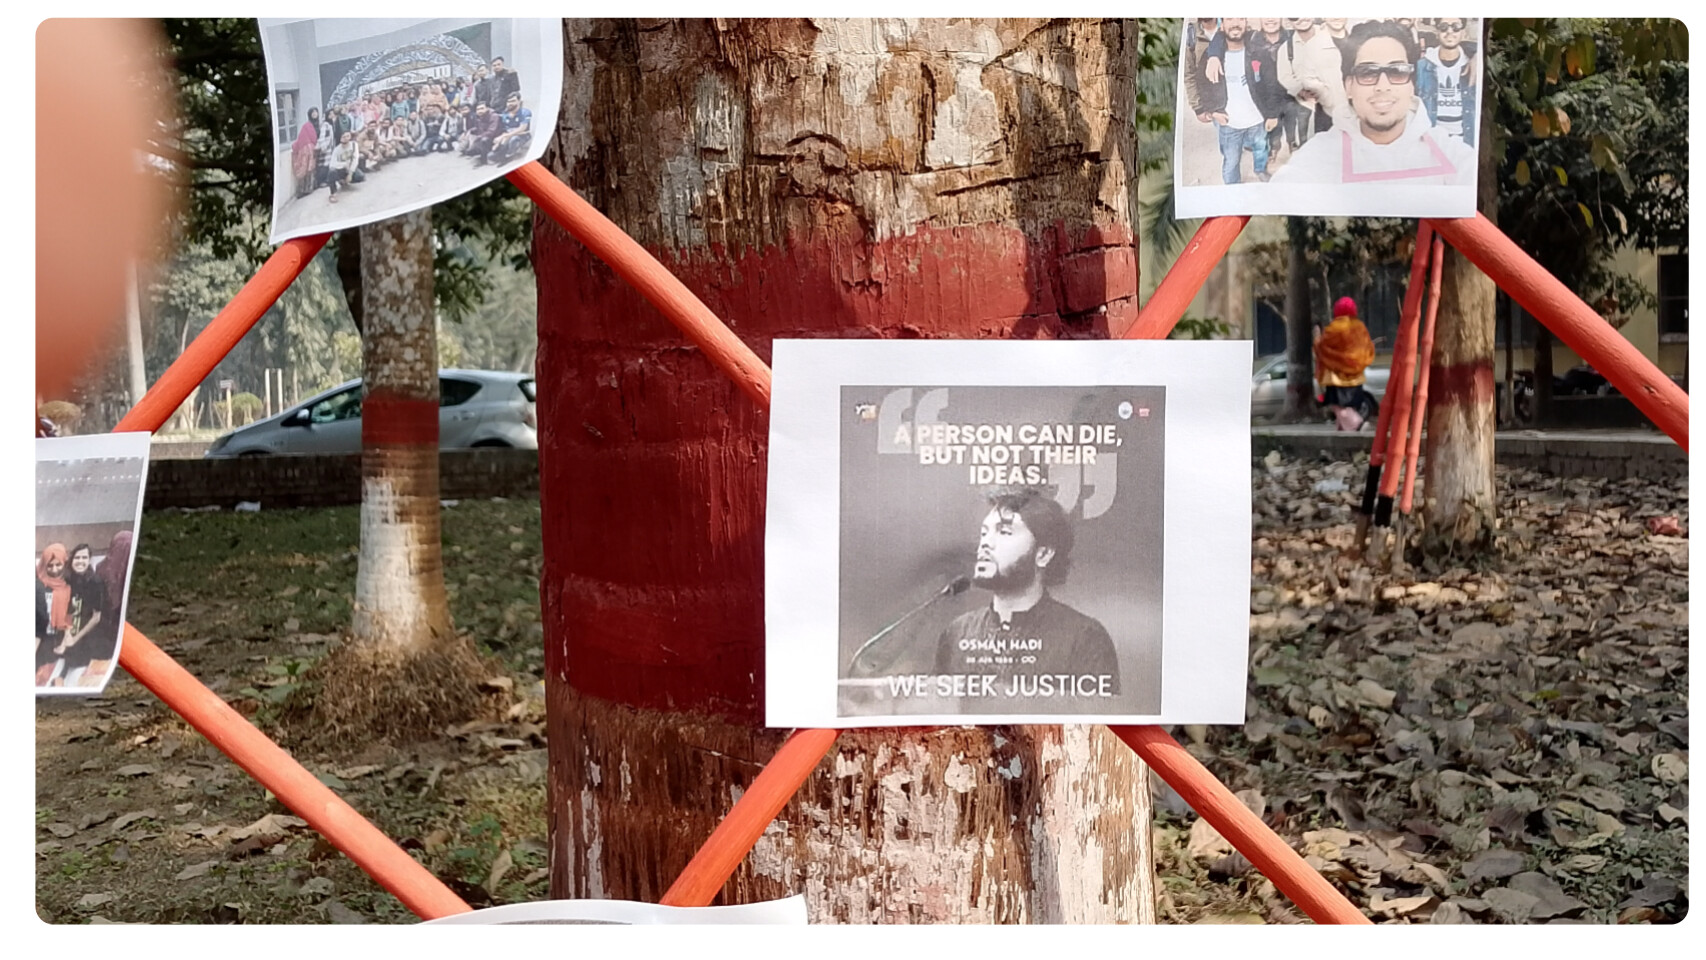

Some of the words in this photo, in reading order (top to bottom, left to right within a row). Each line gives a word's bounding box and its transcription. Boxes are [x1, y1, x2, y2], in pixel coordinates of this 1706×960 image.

[894, 423, 911, 444] A
[916, 424, 1013, 445] PERSON
[1018, 424, 1074, 445] CAN
[1079, 424, 1123, 448] DIE,
[919, 444, 967, 465] BUT
[972, 444, 1025, 465] NOT
[1029, 444, 1097, 466] THEIR
[969, 465, 1047, 486] IDEAS.
[958, 638, 1006, 651] OSMAN
[1010, 638, 1043, 651] HADI
[887, 674, 929, 697] WE
[936, 673, 998, 697] SEEK
[1004, 673, 1112, 698] JUSTICE
